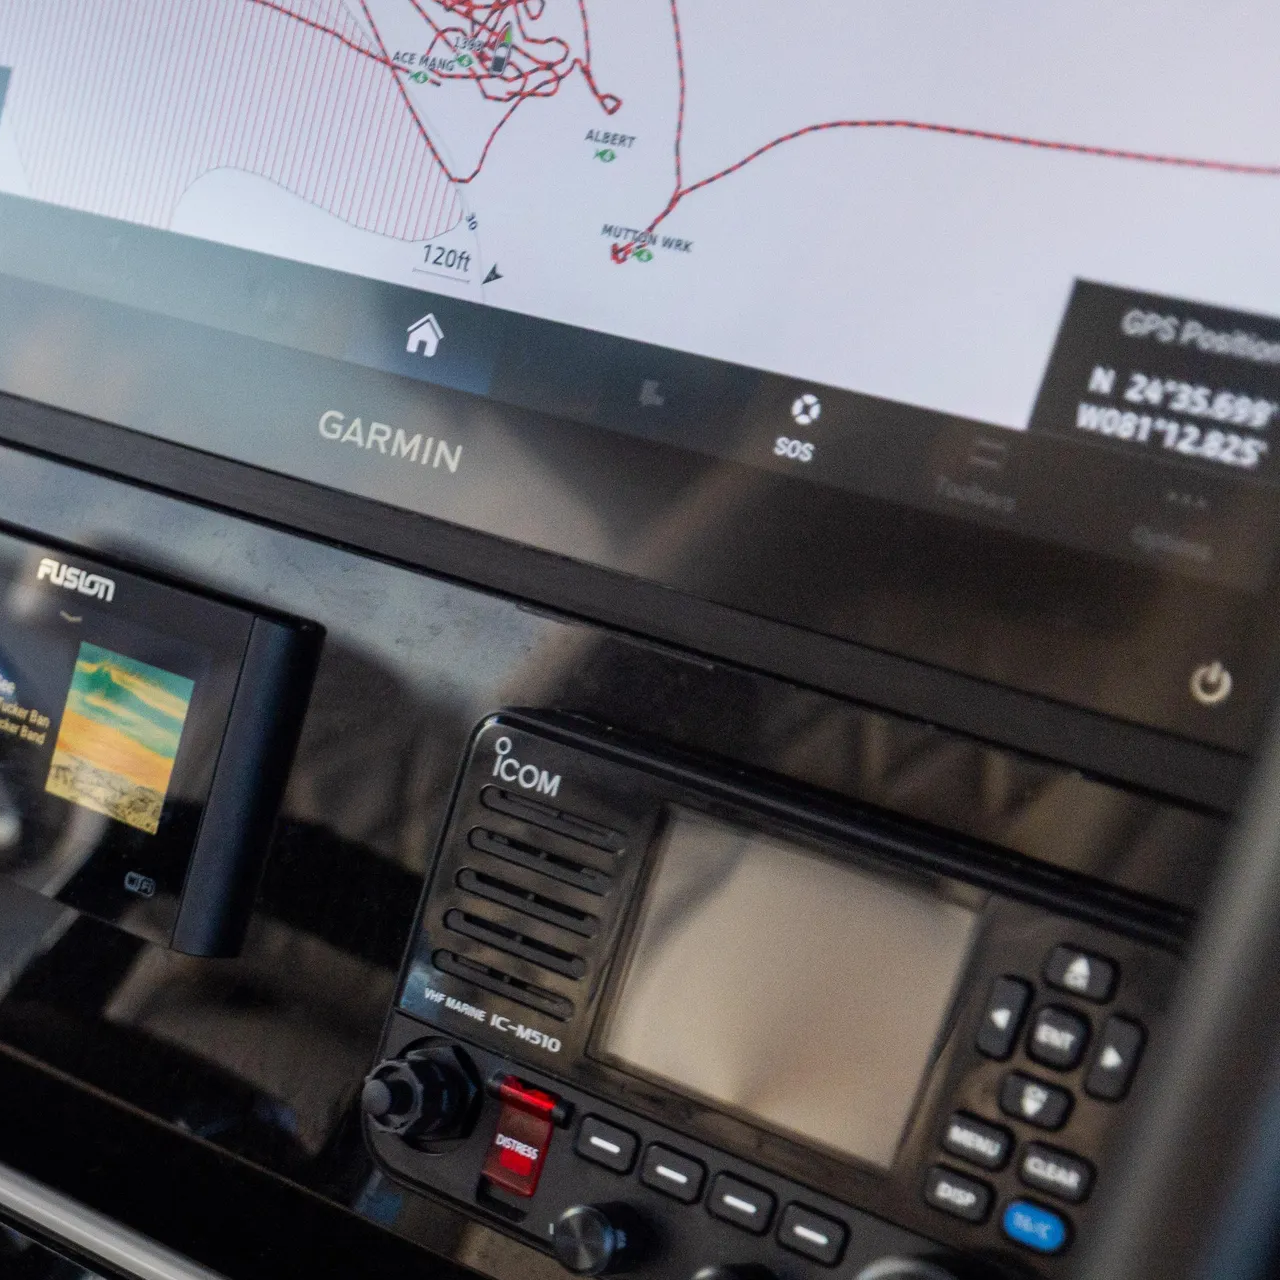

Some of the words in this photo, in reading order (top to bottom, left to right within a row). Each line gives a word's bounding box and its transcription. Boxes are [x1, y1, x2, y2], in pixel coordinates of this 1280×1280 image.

[392, 51, 416, 65] ACE
[418, 54, 454, 72] MANG
[585, 129, 636, 148] ALBERT
[601, 224, 658, 246] MUTTON
[661, 236, 694, 253] WRK
[422, 244, 472, 272] 120ft
[1121, 308, 1178, 344] GPS
[1087, 365, 1116, 395] N
[318, 410, 463, 473] GARMIN
[774, 436, 815, 462] SOS
[37, 558, 115, 602] FUSION
[492, 736, 561, 797] ICOM
[424, 986, 446, 1004] VHF
[444, 996, 487, 1022] MARINE
[489, 1013, 562, 1053] IC-M510
[495, 1132, 539, 1161] DISTRESS
[948, 1124, 1002, 1158] MENU
[1024, 1155, 1082, 1190] CLEAR
